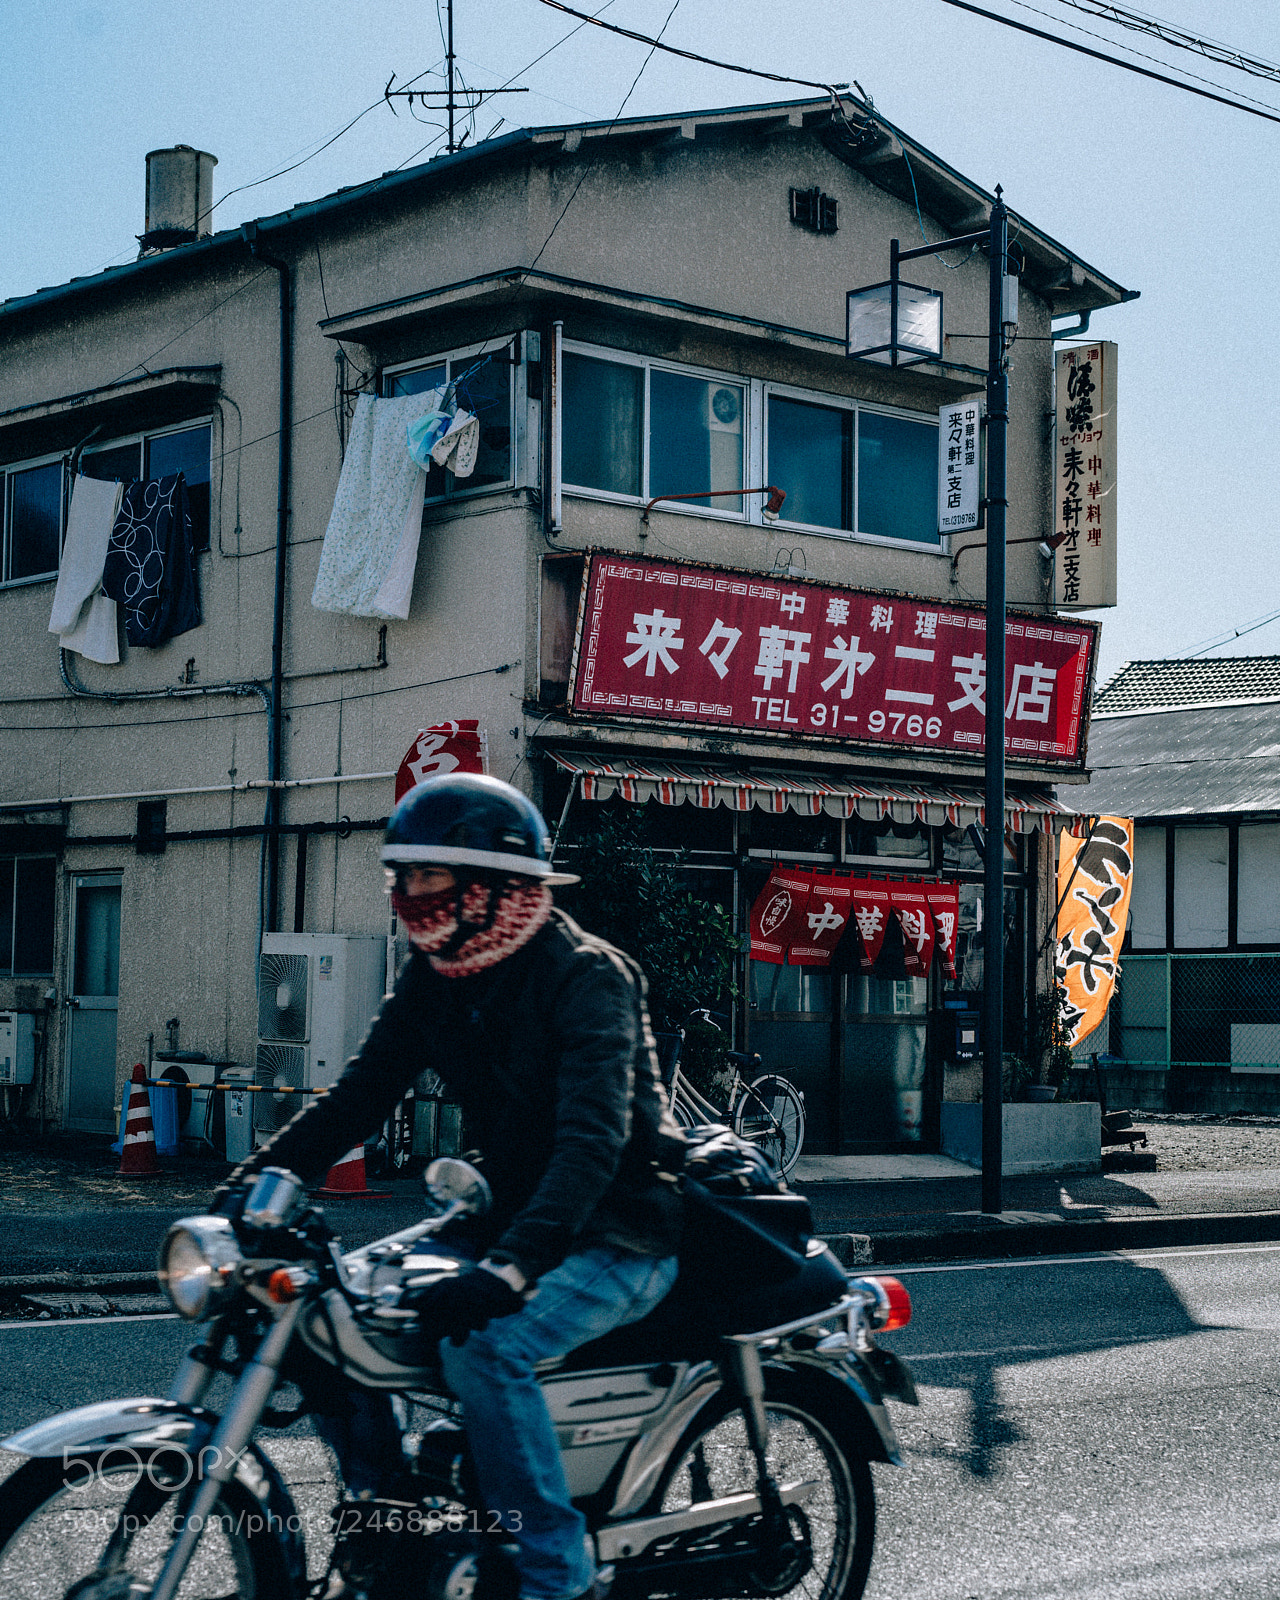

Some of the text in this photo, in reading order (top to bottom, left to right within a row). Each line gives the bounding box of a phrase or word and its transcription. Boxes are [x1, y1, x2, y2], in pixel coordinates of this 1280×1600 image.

[1062, 348, 1099, 366] 清酒
[965, 409, 975, 466] 中華料理
[1059, 430, 1103, 447] セイリョウ
[1086, 455, 1103, 548] 中華料理
[780, 591, 939, 640] 中華料理
[751, 696, 799, 725] TEL
